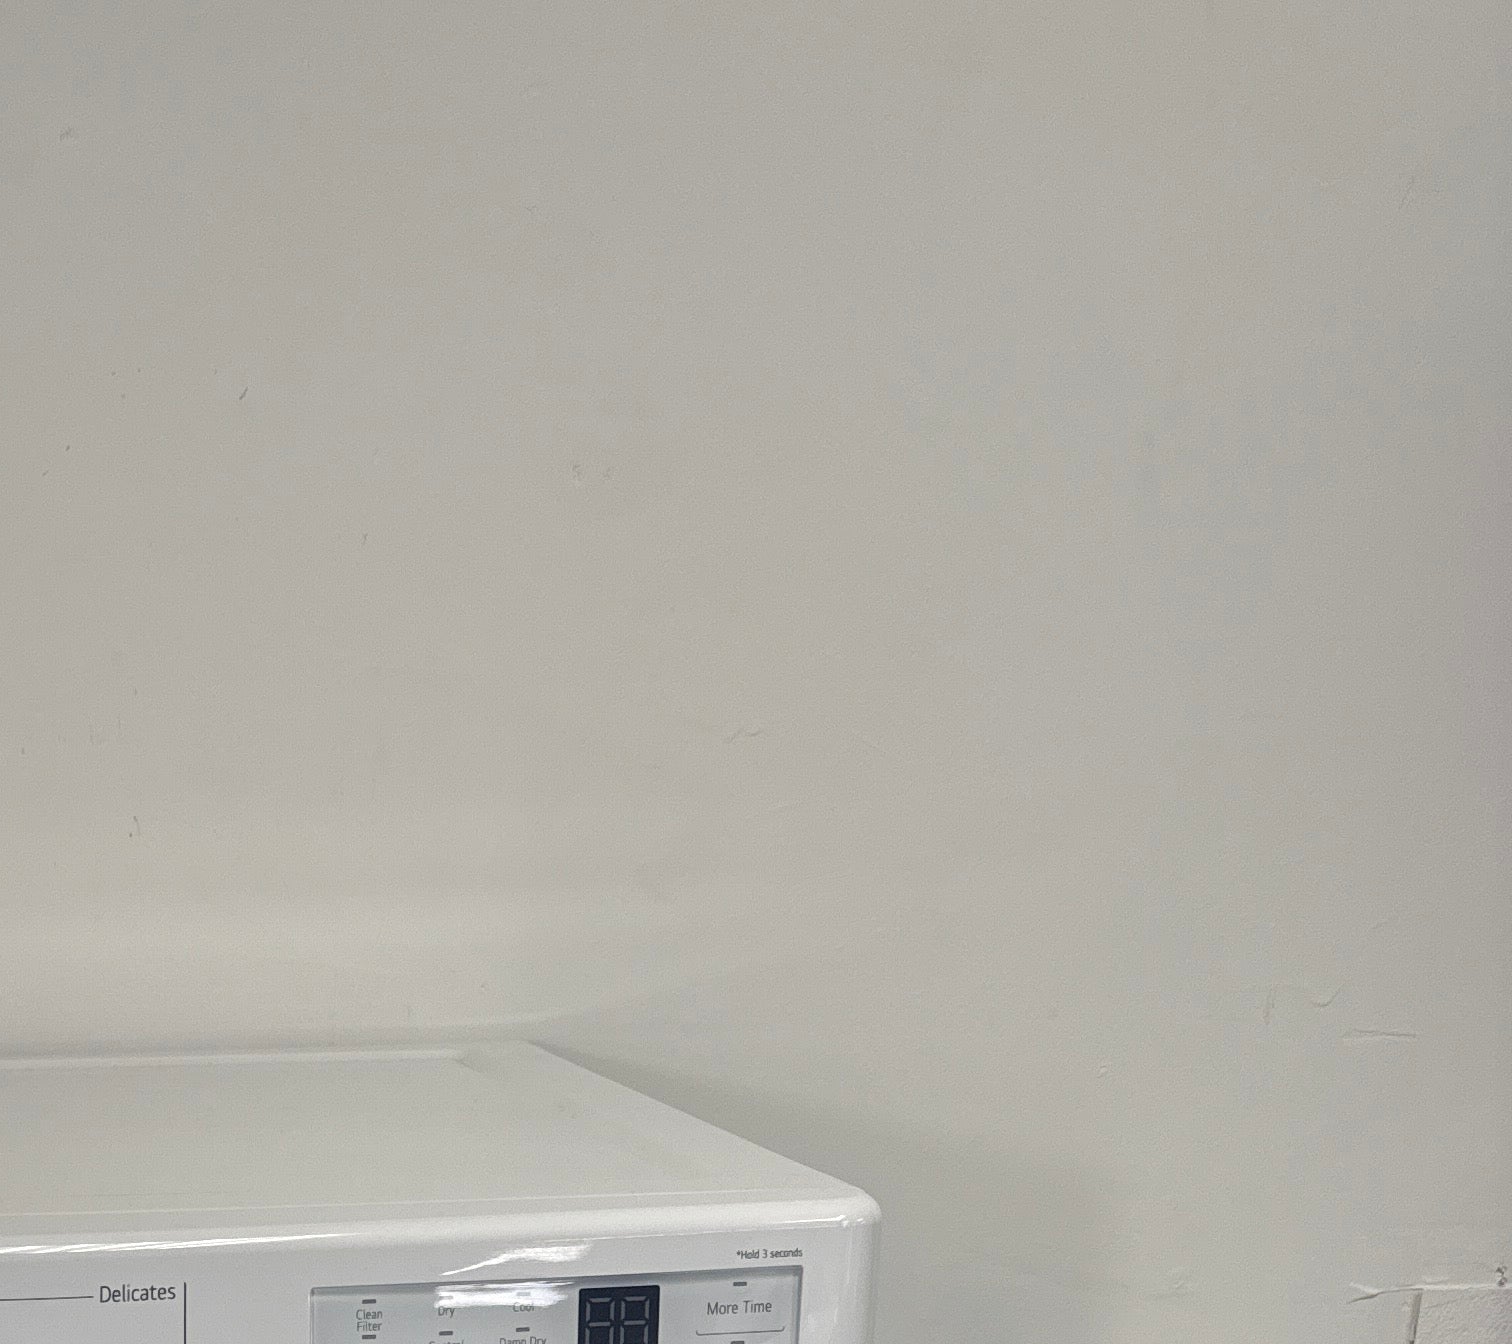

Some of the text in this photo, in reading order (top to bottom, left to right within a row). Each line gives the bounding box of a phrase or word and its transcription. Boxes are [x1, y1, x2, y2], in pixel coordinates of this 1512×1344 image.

[762, 1249, 768, 1259] 3
[770, 1247, 803, 1258] seconds
[99, 1283, 177, 1303] Delicates
[437, 1305, 456, 1318] Dry
[706, 1300, 773, 1315] More Time
[355, 1308, 383, 1321] Clean
[356, 1321, 383, 1332] Filter
